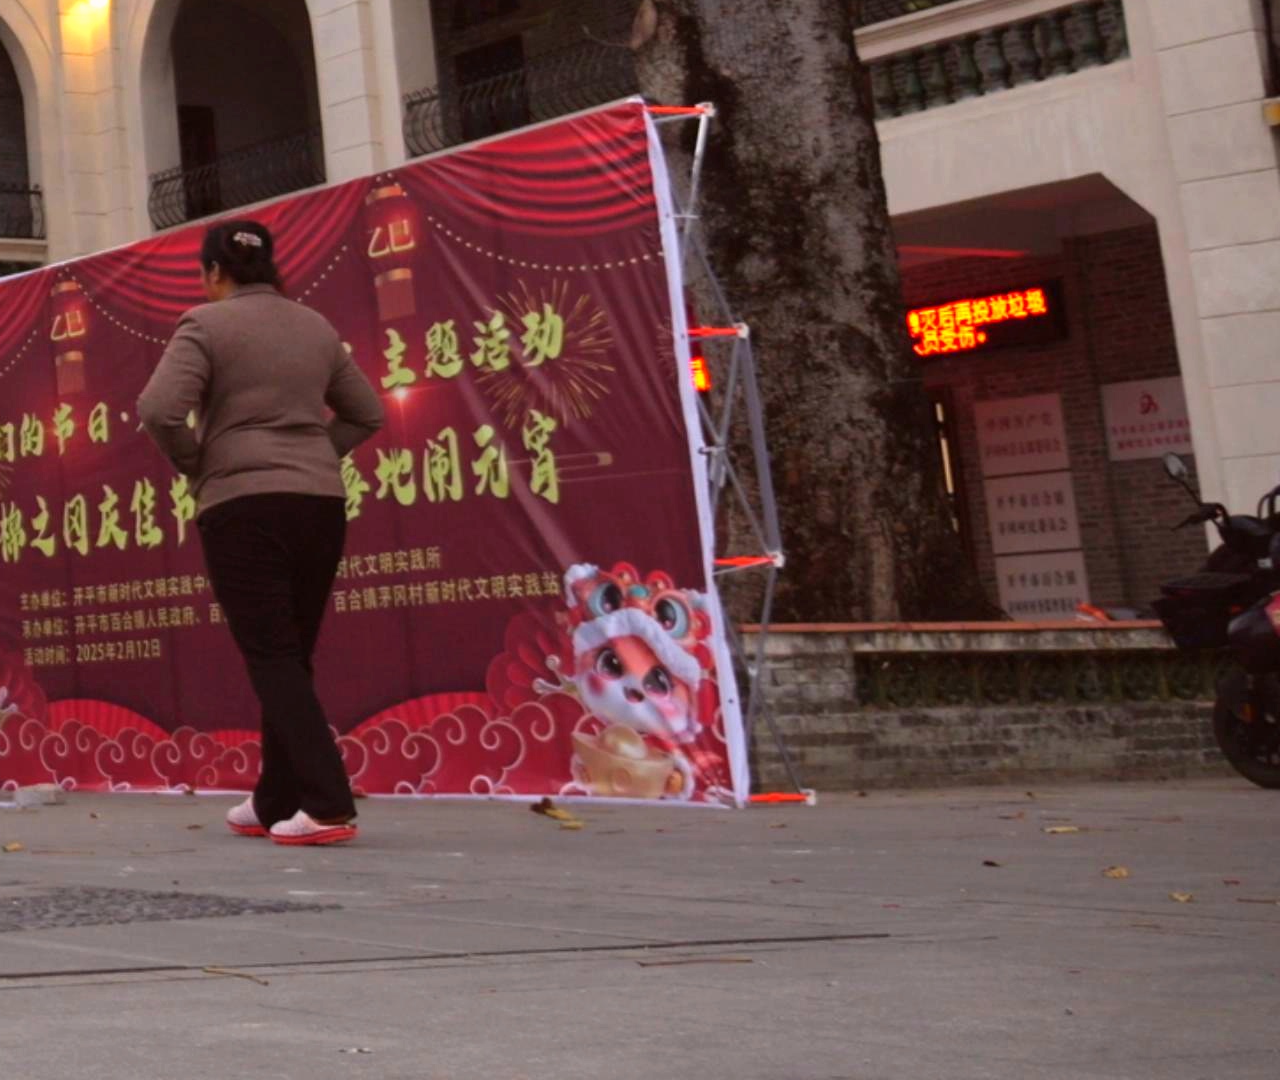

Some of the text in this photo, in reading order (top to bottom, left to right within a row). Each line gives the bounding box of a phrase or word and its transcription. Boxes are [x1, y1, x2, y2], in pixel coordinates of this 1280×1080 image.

[381, 302, 565, 389] 主题活动
[20, 575, 211, 610] 主办单位：开平市新时代文明实践中
[22, 603, 228, 639] 承办单位：开平市百合镇人民政府、百
